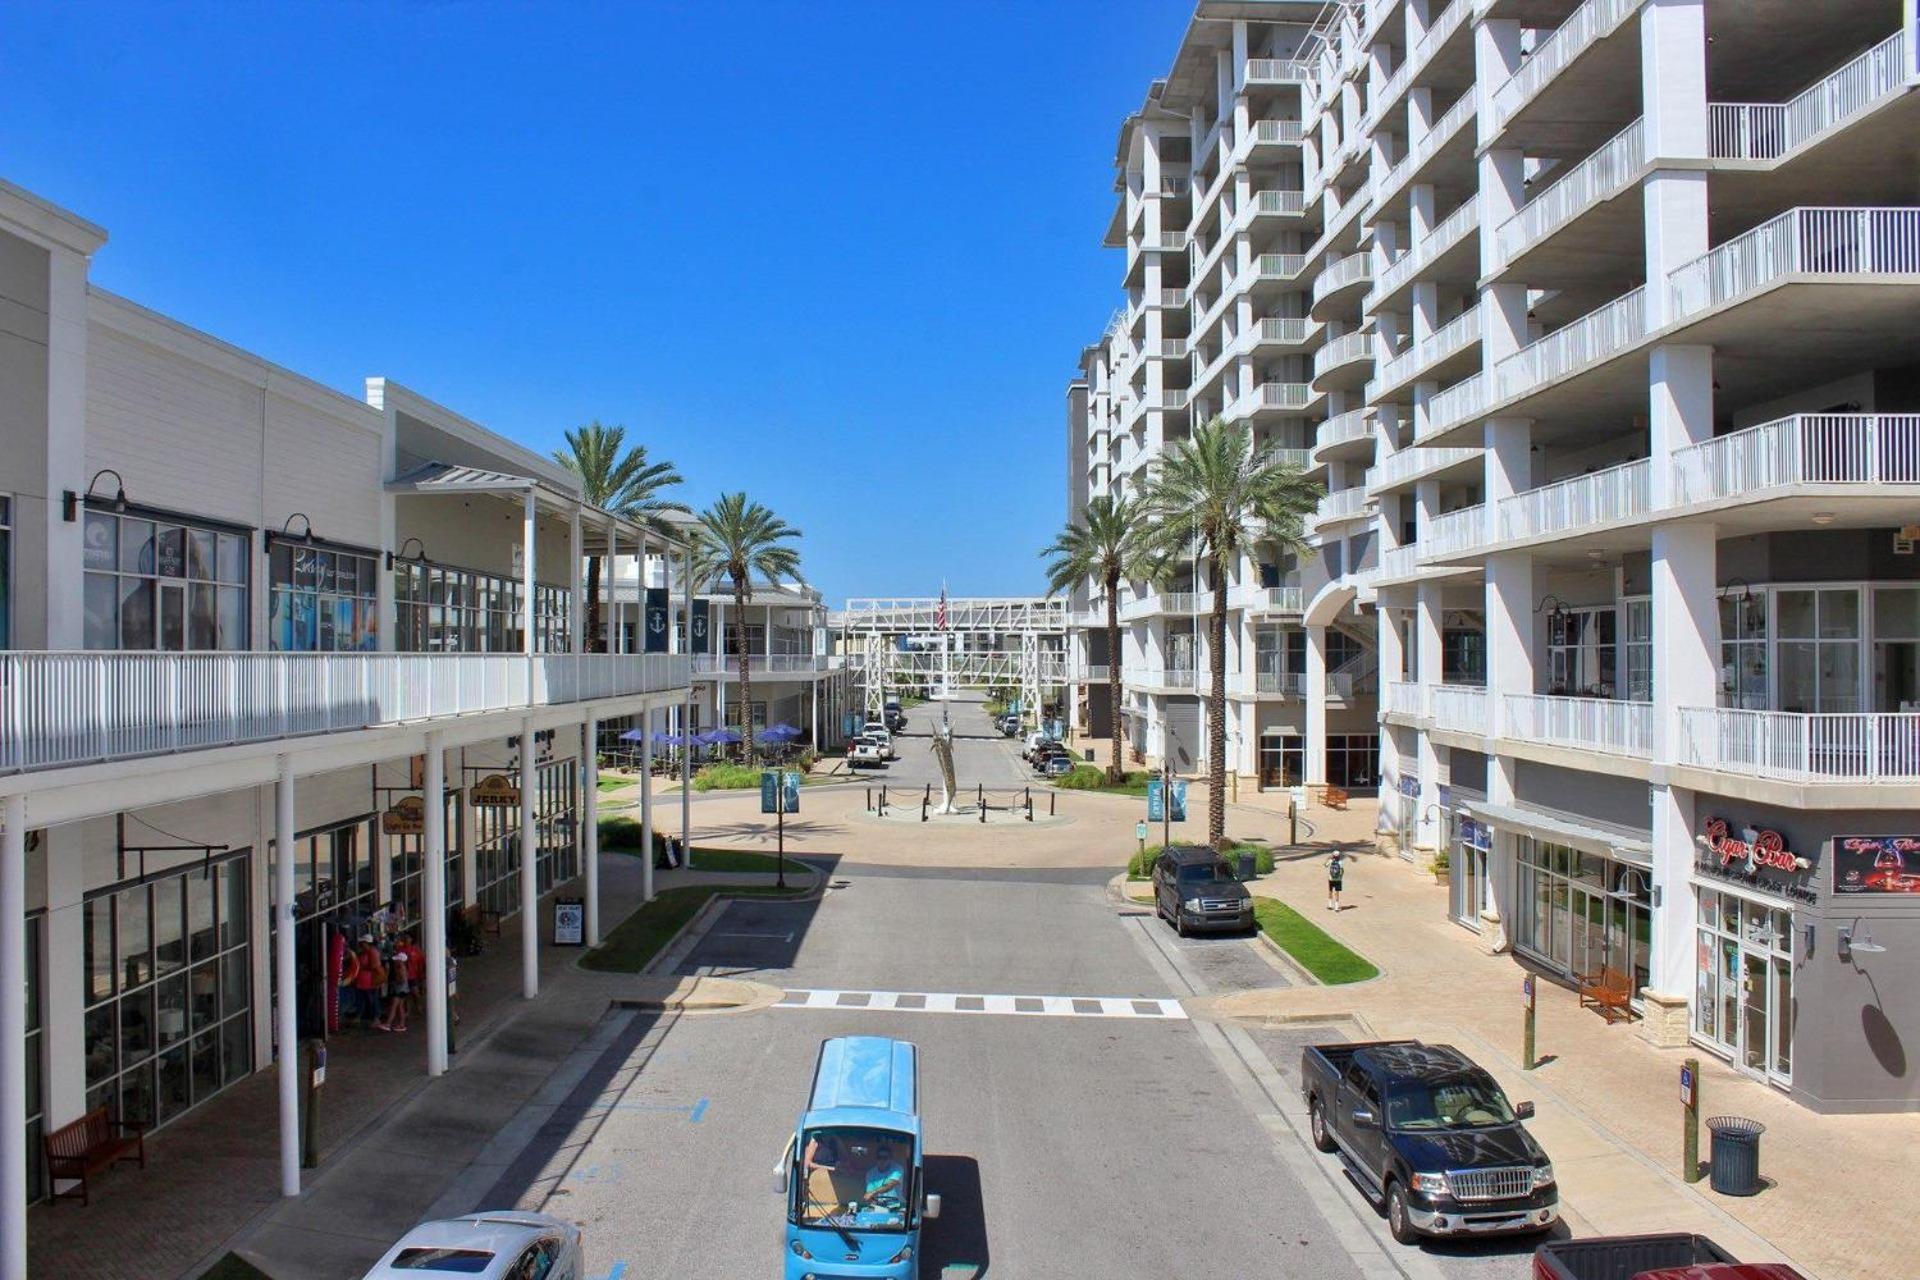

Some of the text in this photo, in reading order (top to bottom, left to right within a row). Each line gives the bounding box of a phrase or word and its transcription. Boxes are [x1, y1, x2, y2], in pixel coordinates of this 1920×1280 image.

[473, 794, 517, 805] JERKY
[1704, 816, 1797, 872] Cigar Bar
